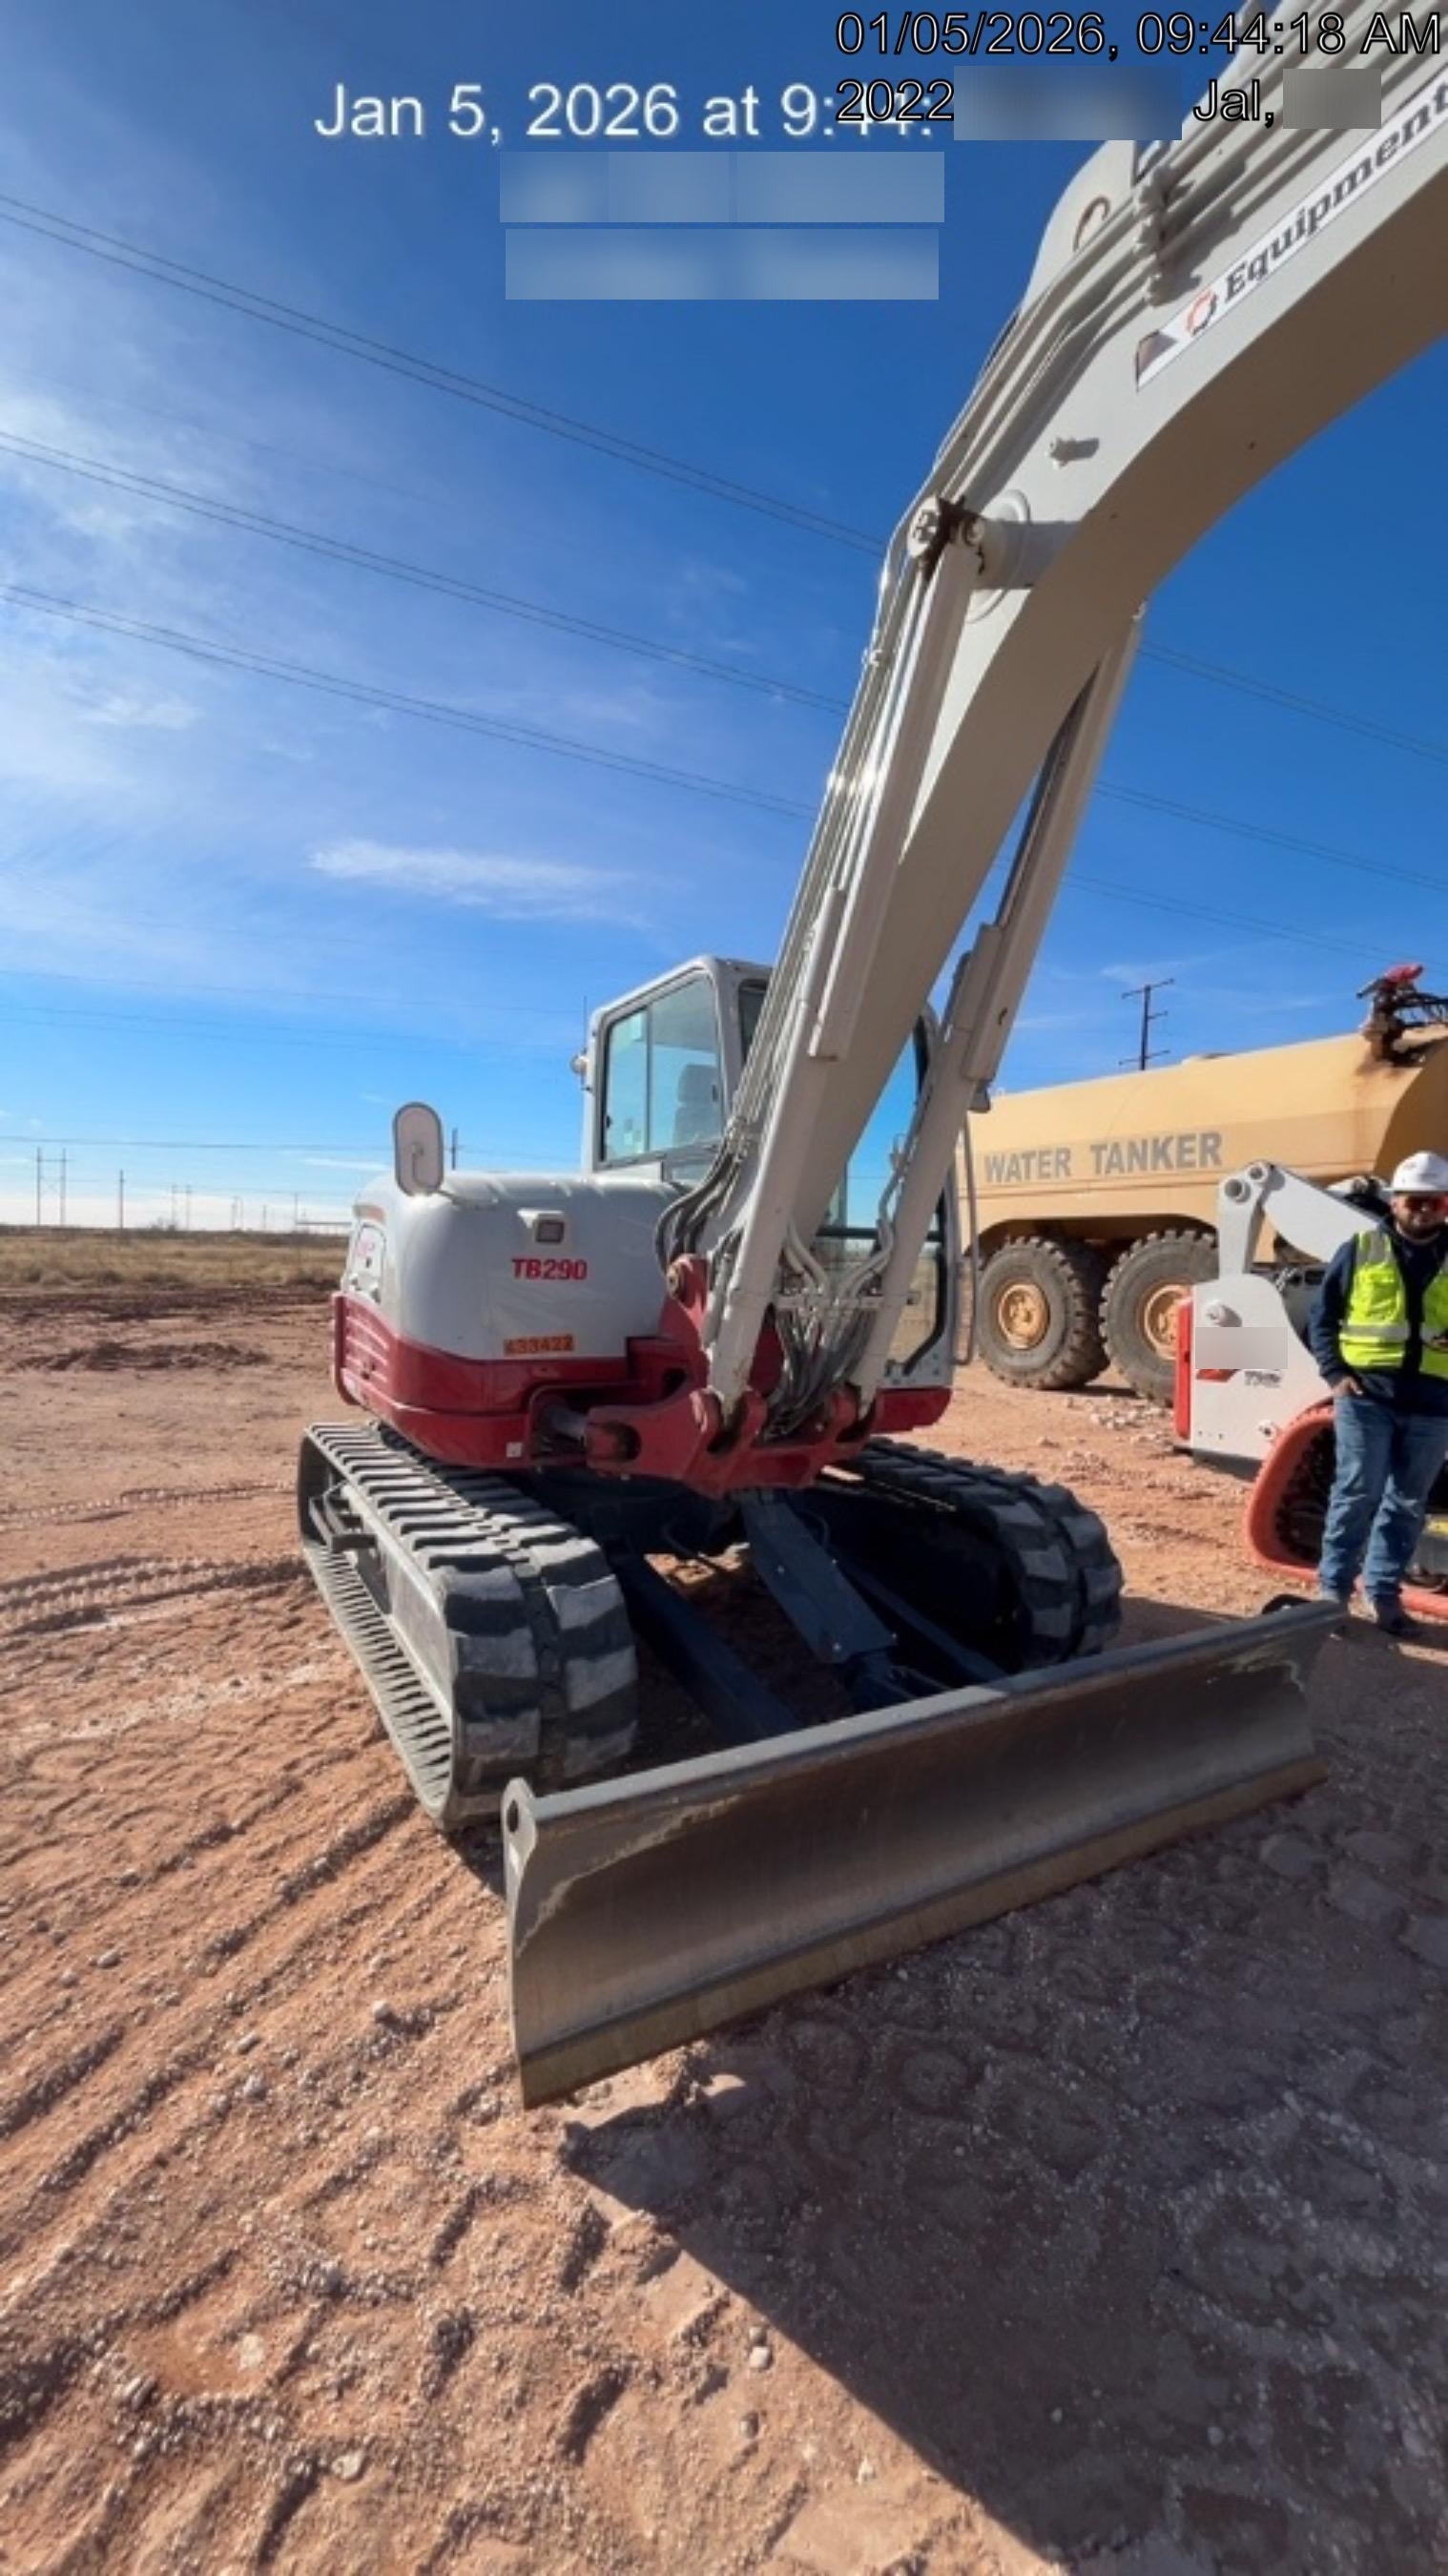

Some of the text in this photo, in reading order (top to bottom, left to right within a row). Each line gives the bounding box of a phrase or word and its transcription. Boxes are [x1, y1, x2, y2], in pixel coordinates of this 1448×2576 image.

[1225, 81, 1448, 303] Equipment
[983, 1131, 1223, 1184] WATER TANKER
[511, 1257, 589, 1280] TB290
